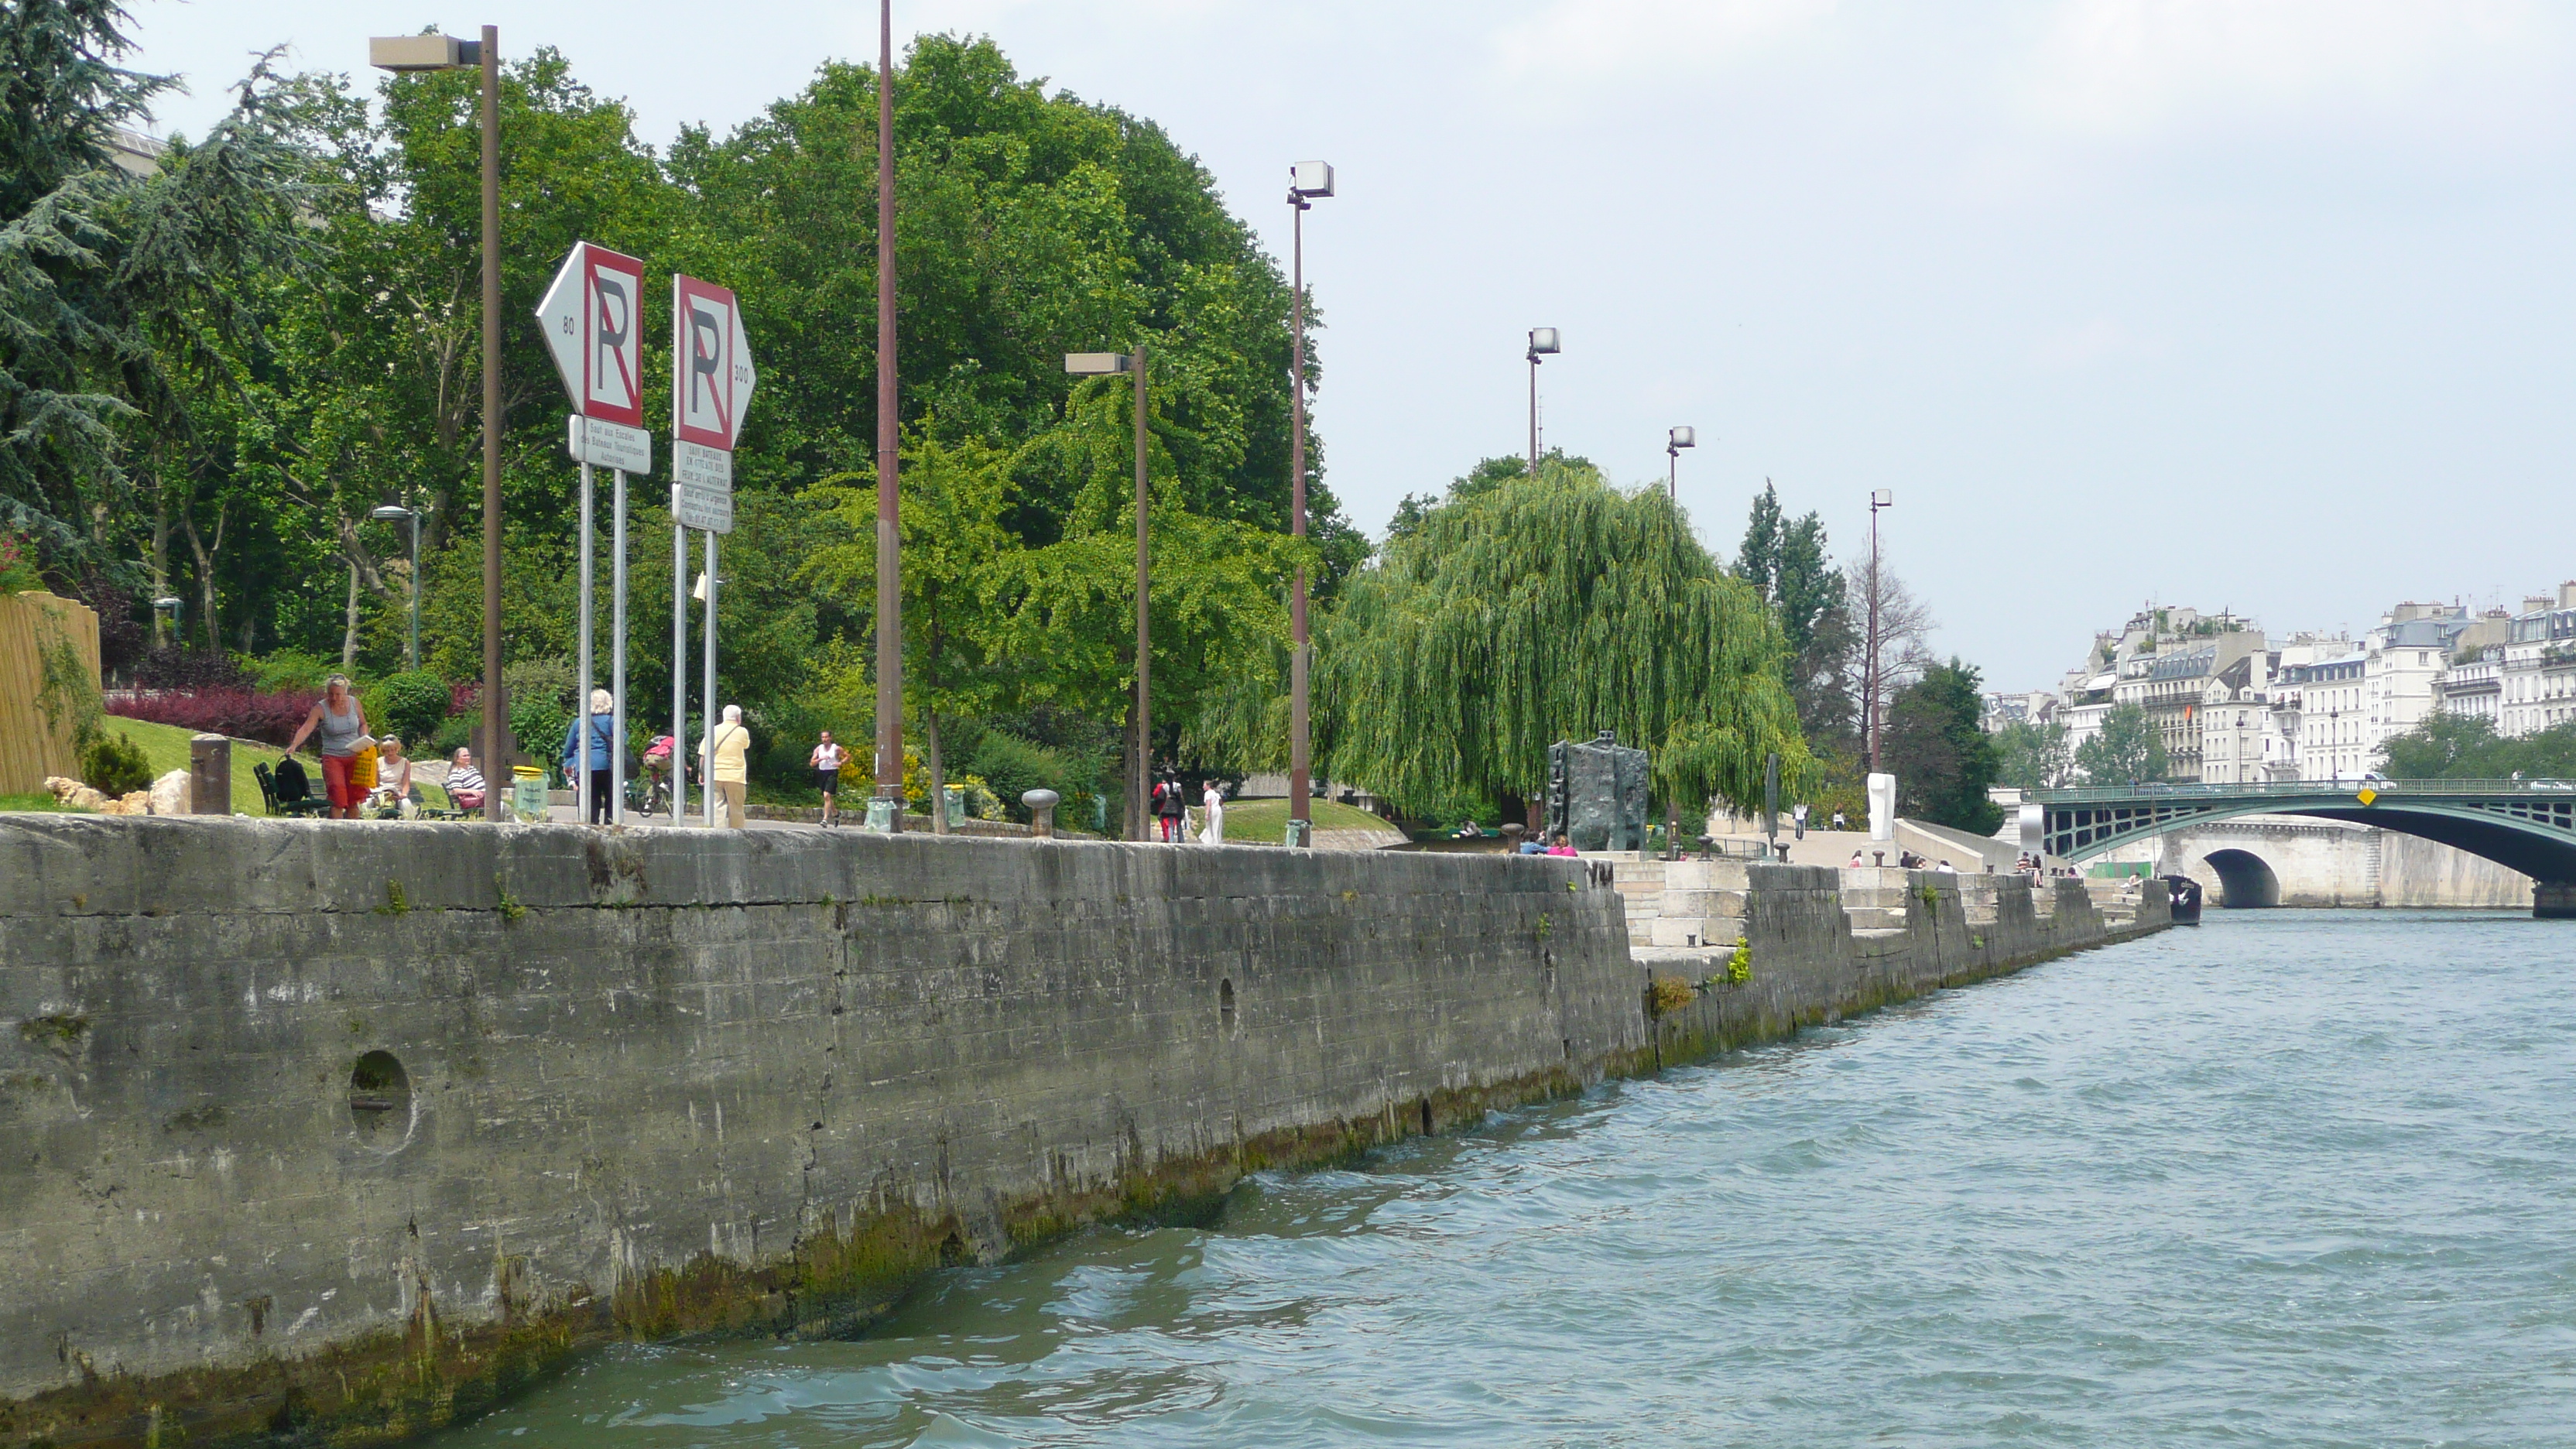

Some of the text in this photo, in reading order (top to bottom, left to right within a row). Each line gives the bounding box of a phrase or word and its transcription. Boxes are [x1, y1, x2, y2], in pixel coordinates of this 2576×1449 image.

[564, 316, 574, 335] 80
[598, 277, 629, 389] P
[692, 309, 721, 413] P
[735, 365, 748, 384] 300
[590, 423, 635, 442] Sauf aux Escales
[592, 436, 611, 449] Bateaux
